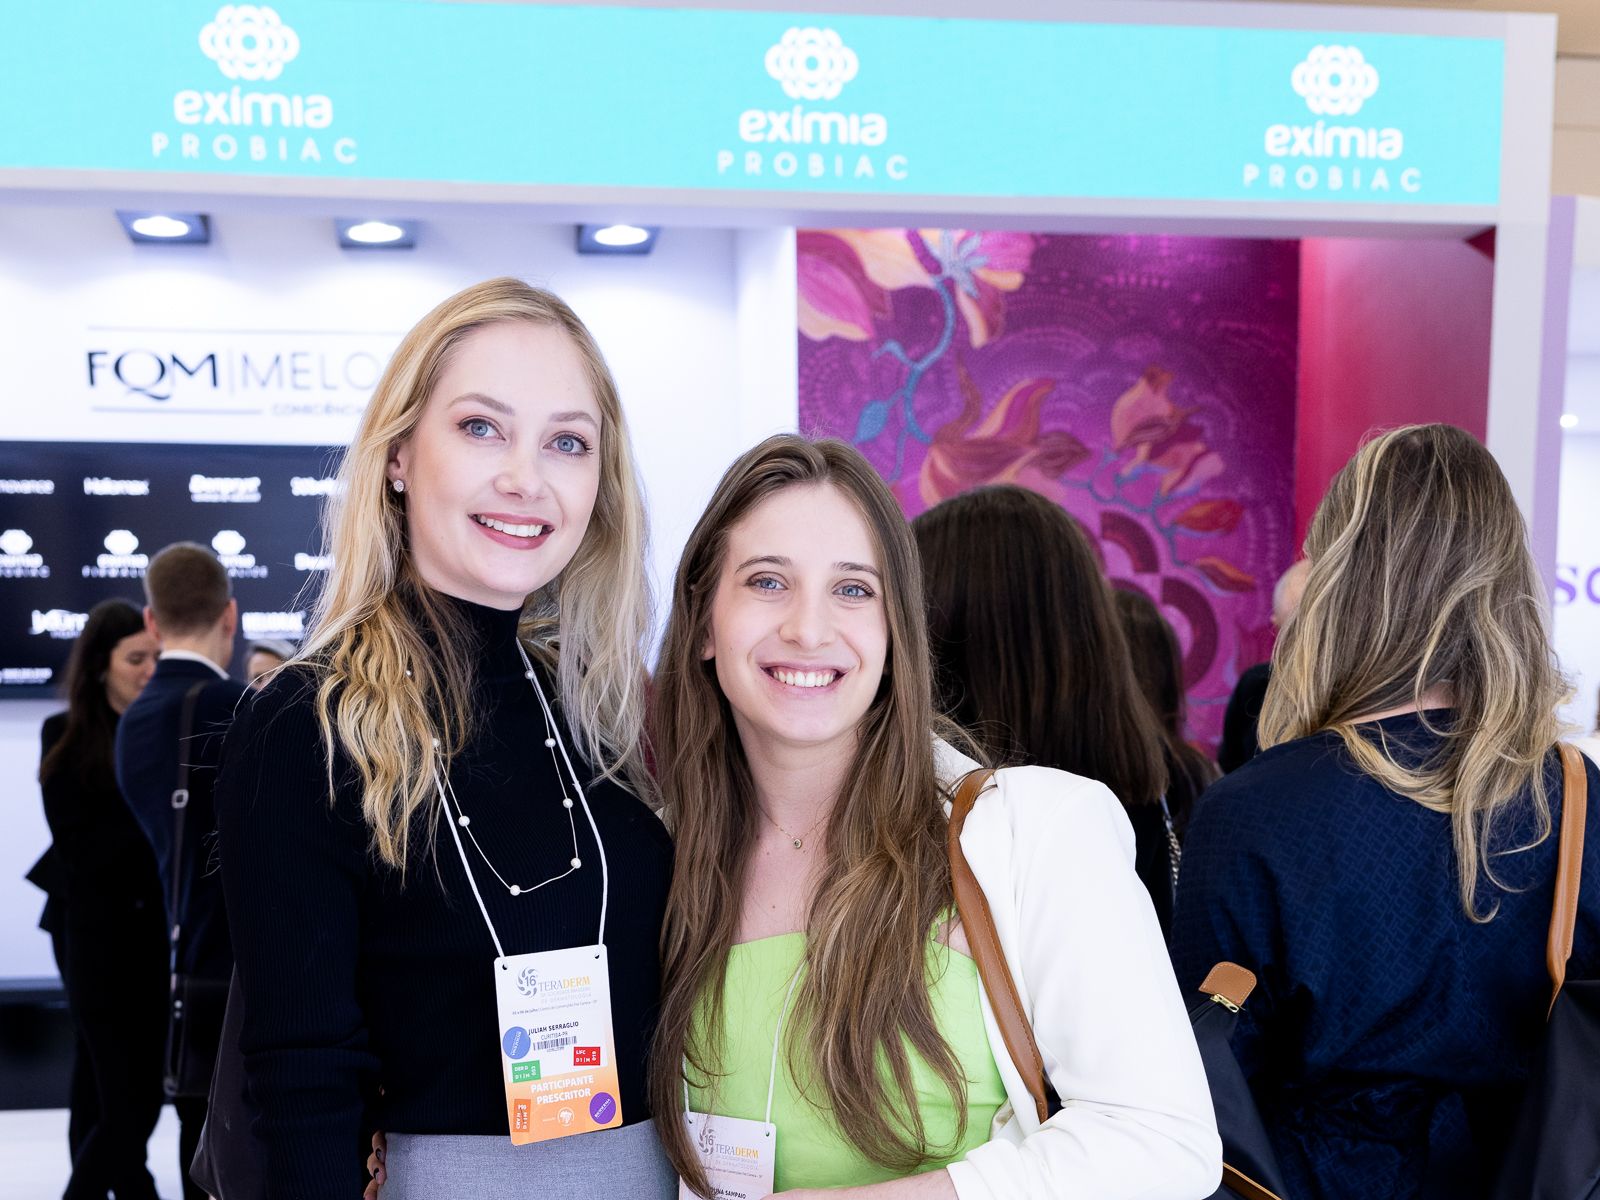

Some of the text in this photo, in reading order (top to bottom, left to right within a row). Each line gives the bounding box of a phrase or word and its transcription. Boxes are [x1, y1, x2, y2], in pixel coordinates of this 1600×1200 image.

[152, 132, 356, 164] PROBIAC
[718, 151, 907, 179] PROBIAC
[1244, 164, 1419, 192] PROBIAC
[85, 350, 390, 400] FQM MELO
[524, 974, 537, 987] 16
[531, 1074, 594, 1093] PARTICIPANTE
[536, 1088, 592, 1104] PRESCRITOR
